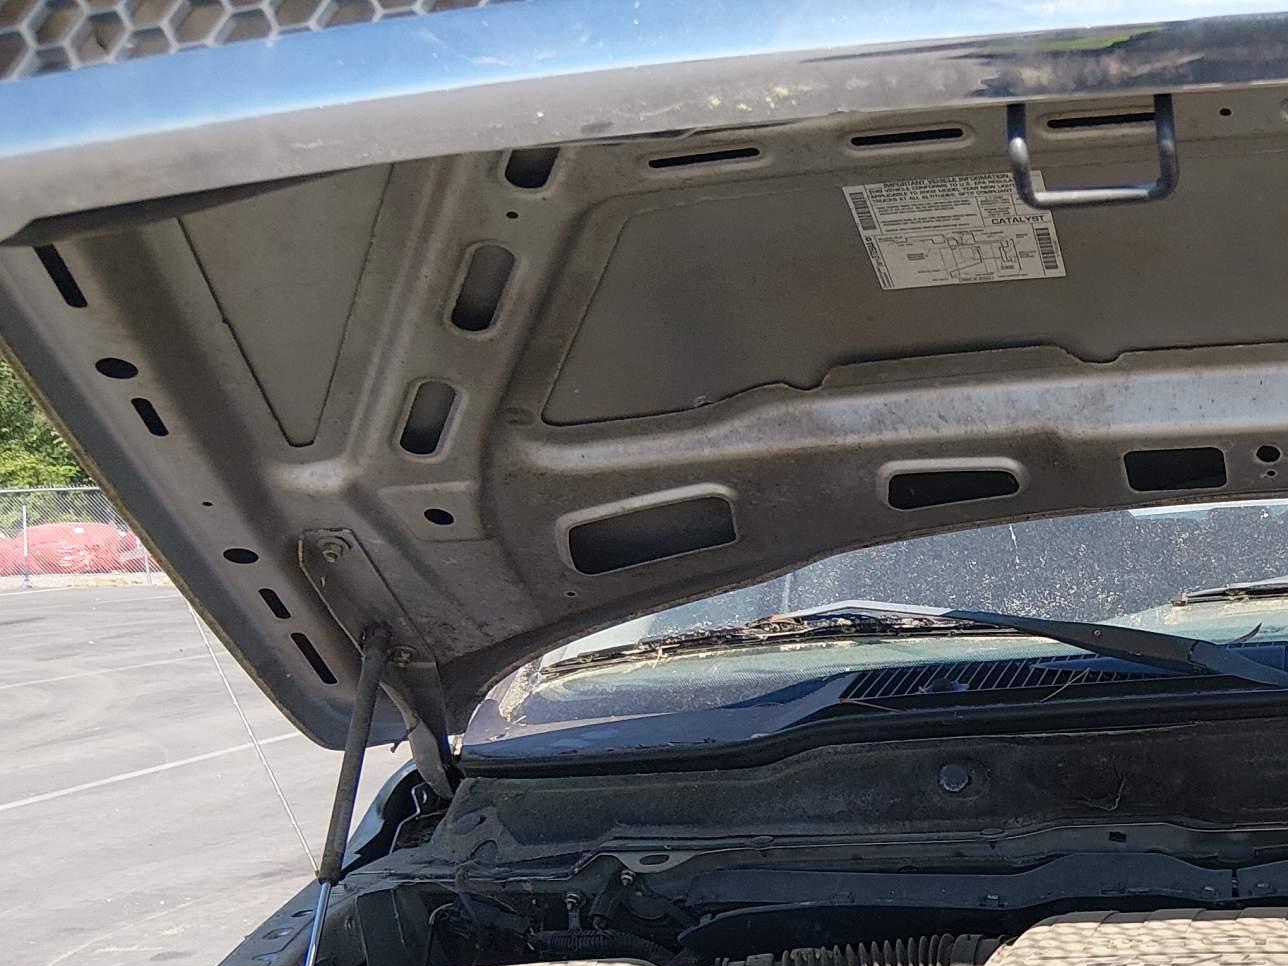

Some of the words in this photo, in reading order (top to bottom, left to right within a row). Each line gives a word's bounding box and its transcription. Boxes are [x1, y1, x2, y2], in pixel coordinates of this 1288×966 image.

[882, 180, 925, 188] IMPORTANT
[957, 173, 1009, 182] INFORMATION
[990, 214, 1045, 225] CATALYST
